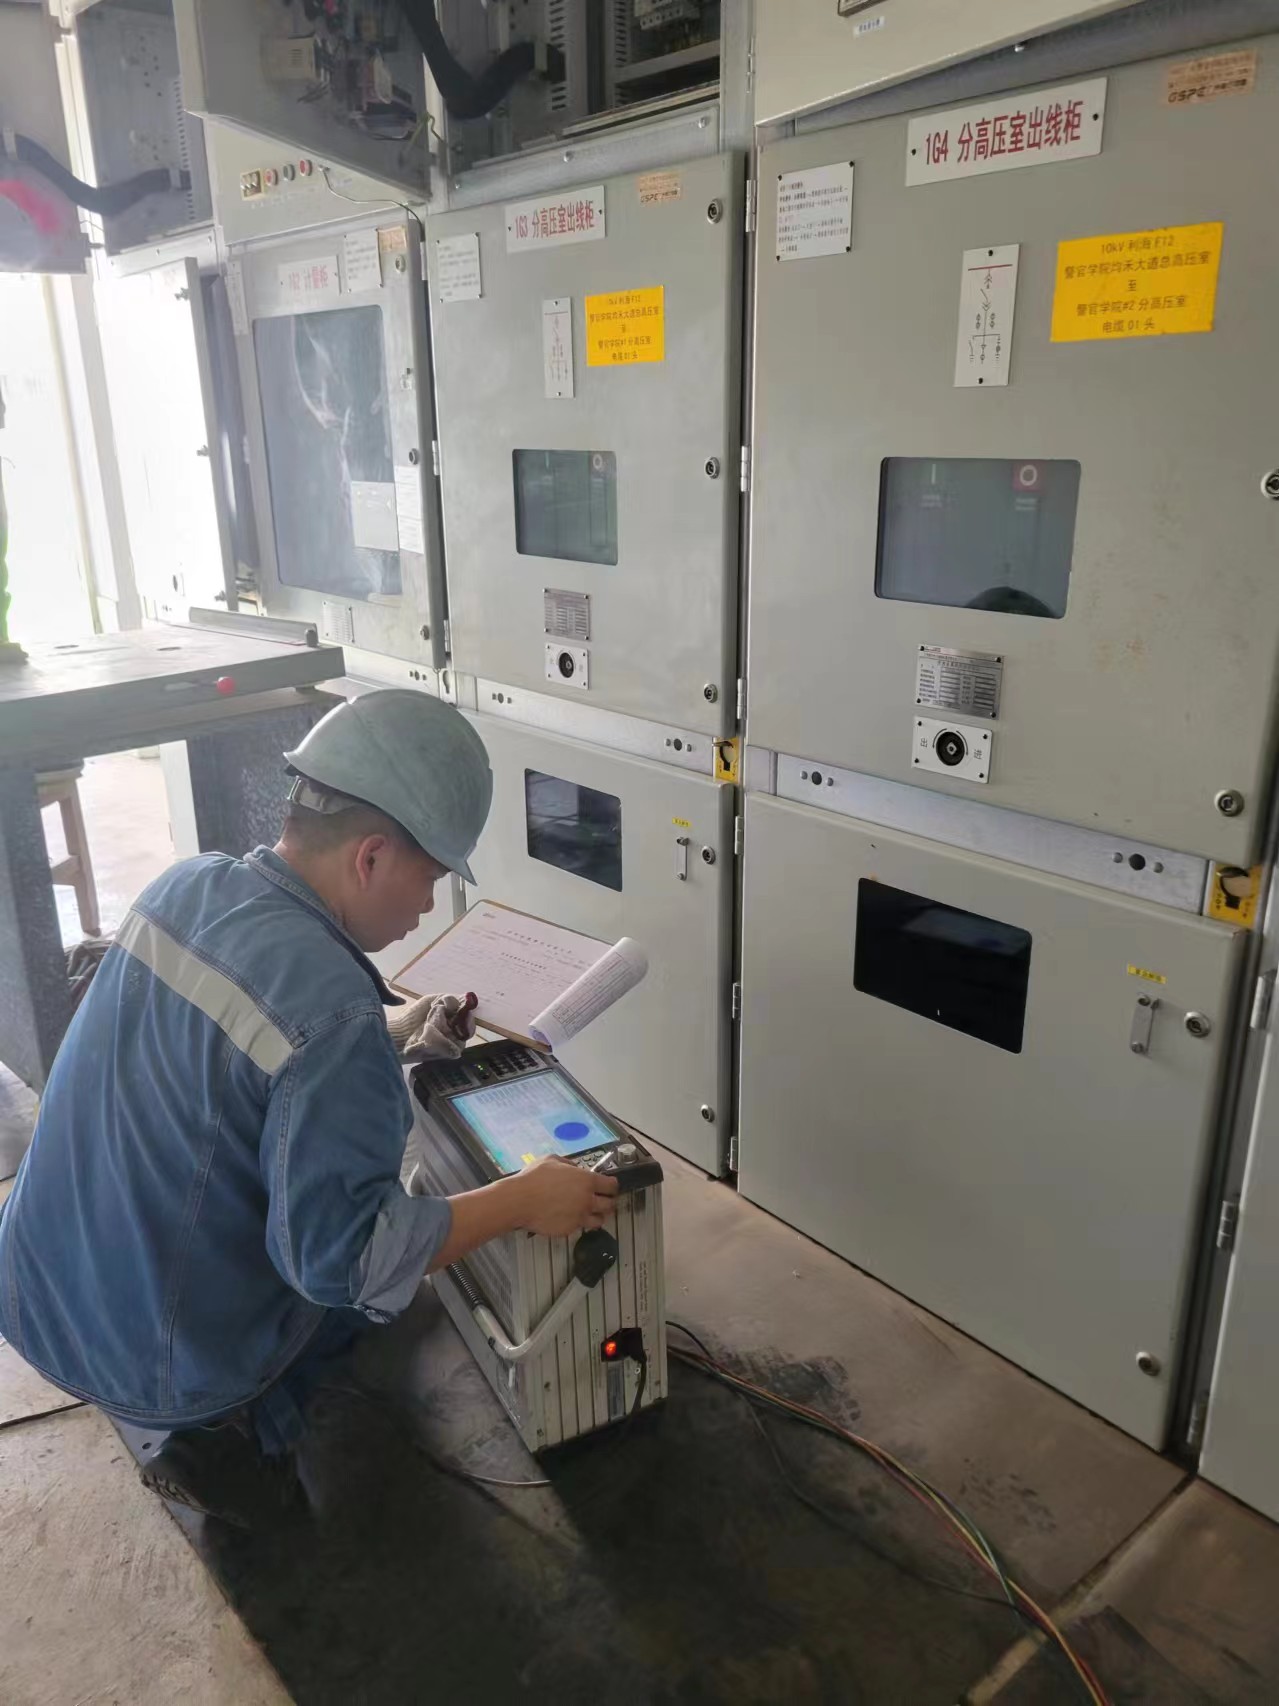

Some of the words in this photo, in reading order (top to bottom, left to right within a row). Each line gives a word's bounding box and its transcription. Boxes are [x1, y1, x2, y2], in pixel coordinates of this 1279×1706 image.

[926, 130, 949, 165] 1G4
[957, 100, 1084, 163] 分高压室出线柜
[532, 200, 595, 239] 分高压室出线柜
[1128, 280, 1137, 292] 至
